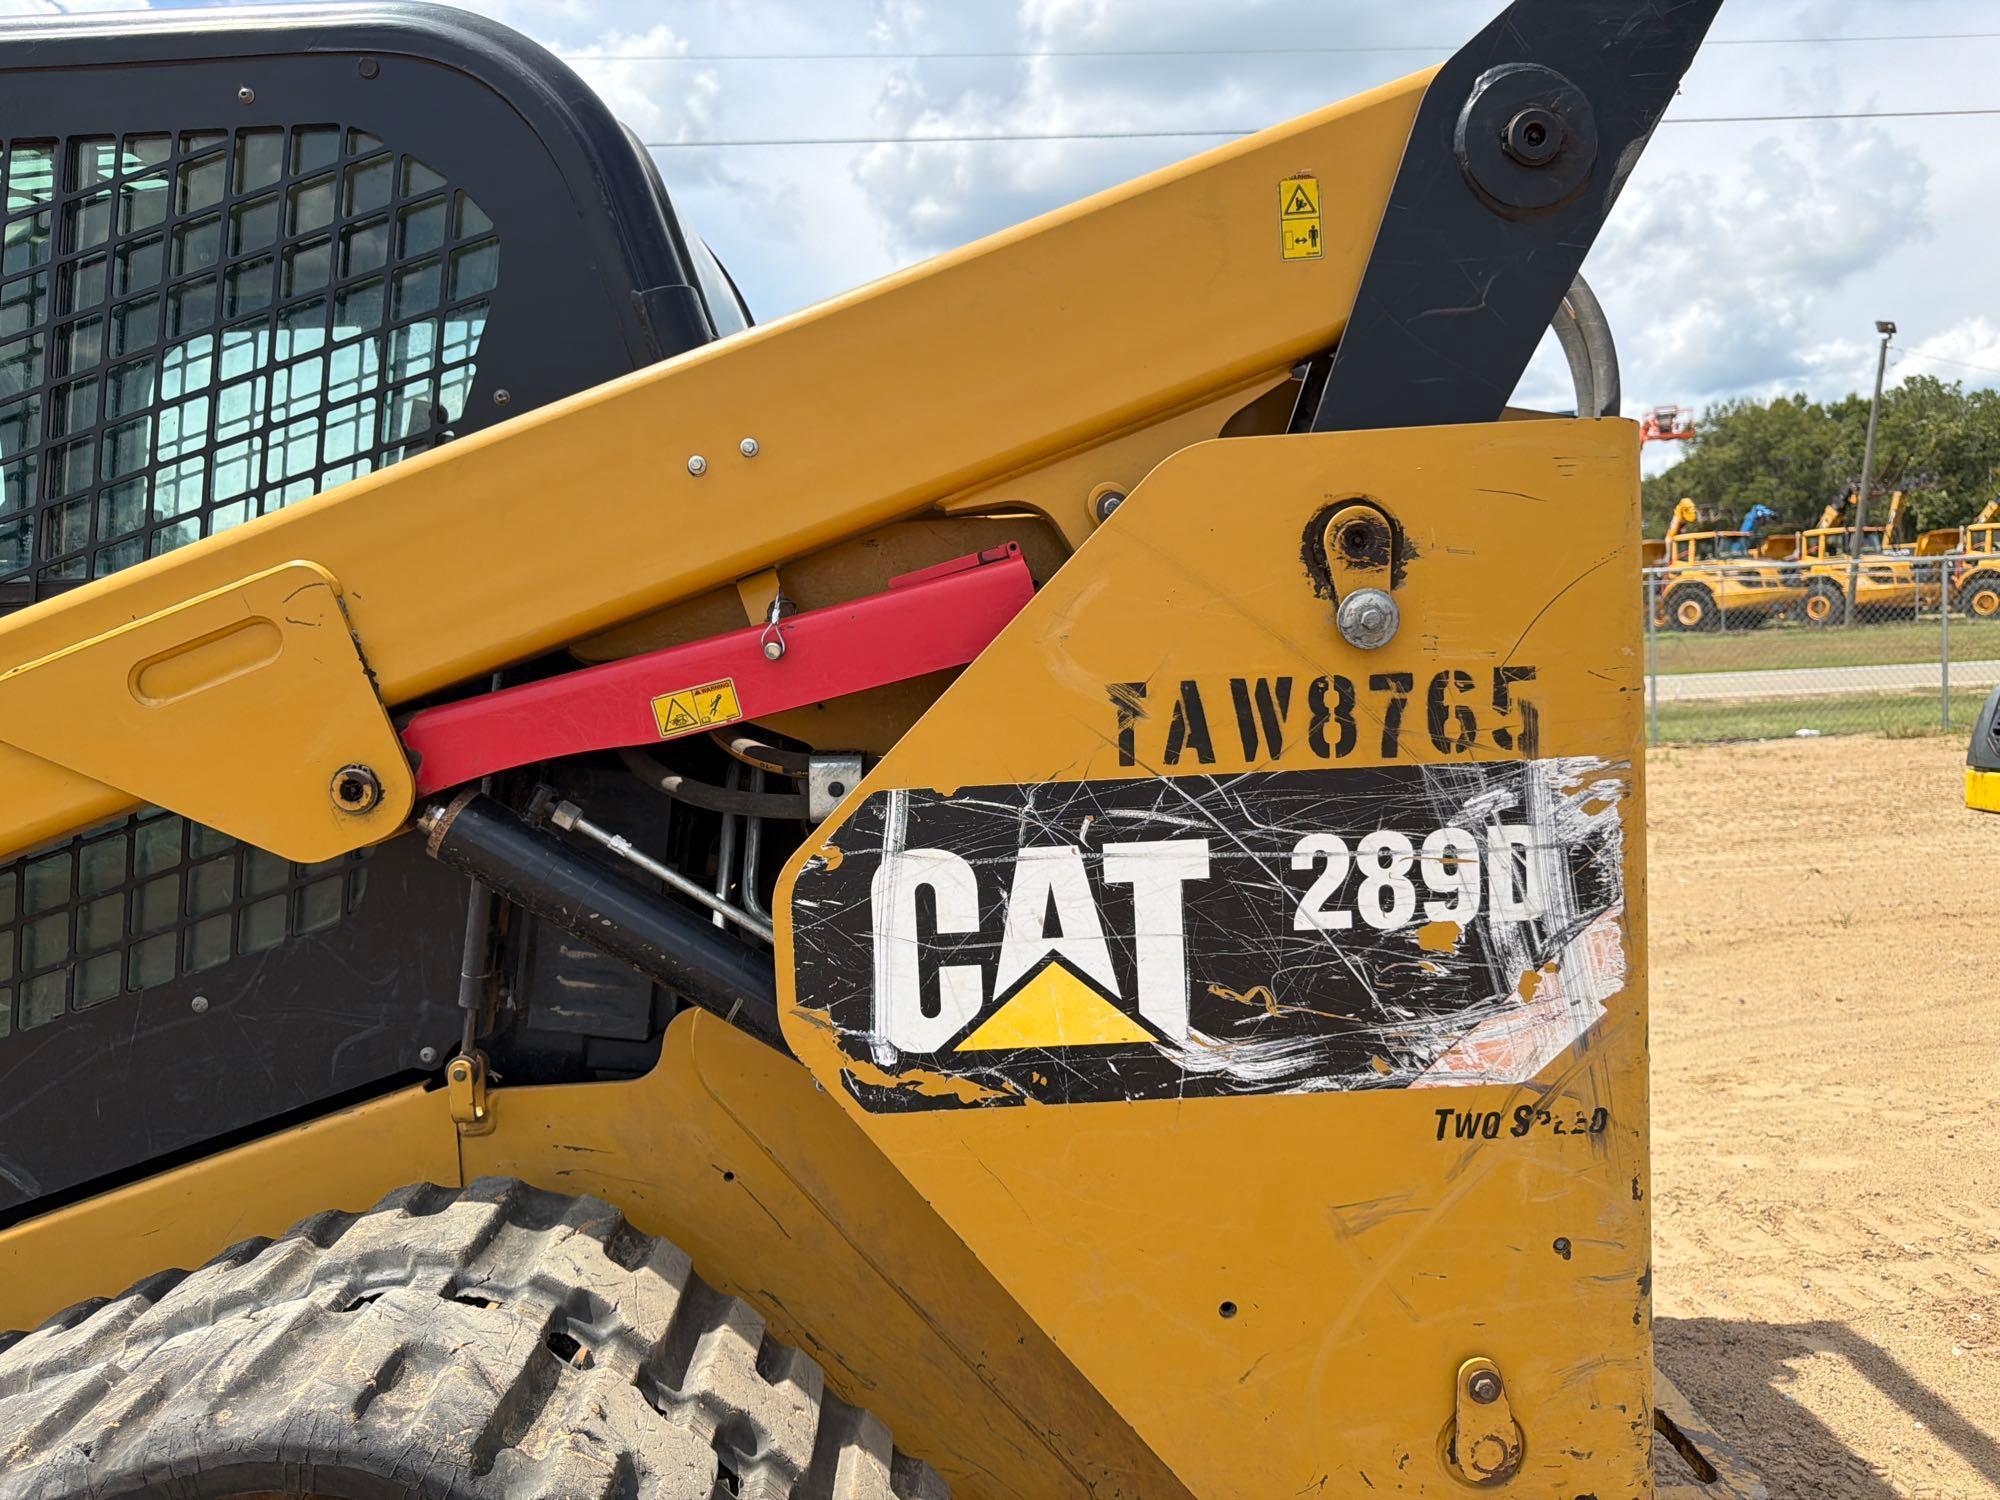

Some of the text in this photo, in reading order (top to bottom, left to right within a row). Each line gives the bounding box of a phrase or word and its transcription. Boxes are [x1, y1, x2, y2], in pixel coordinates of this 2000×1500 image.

[700, 681, 730, 694] WARNING
[1105, 667, 1539, 767] TAW8765
[1291, 825, 1544, 931] 289D
[871, 839, 1210, 1054] CAT
[1435, 1108, 1501, 1141] TWO
